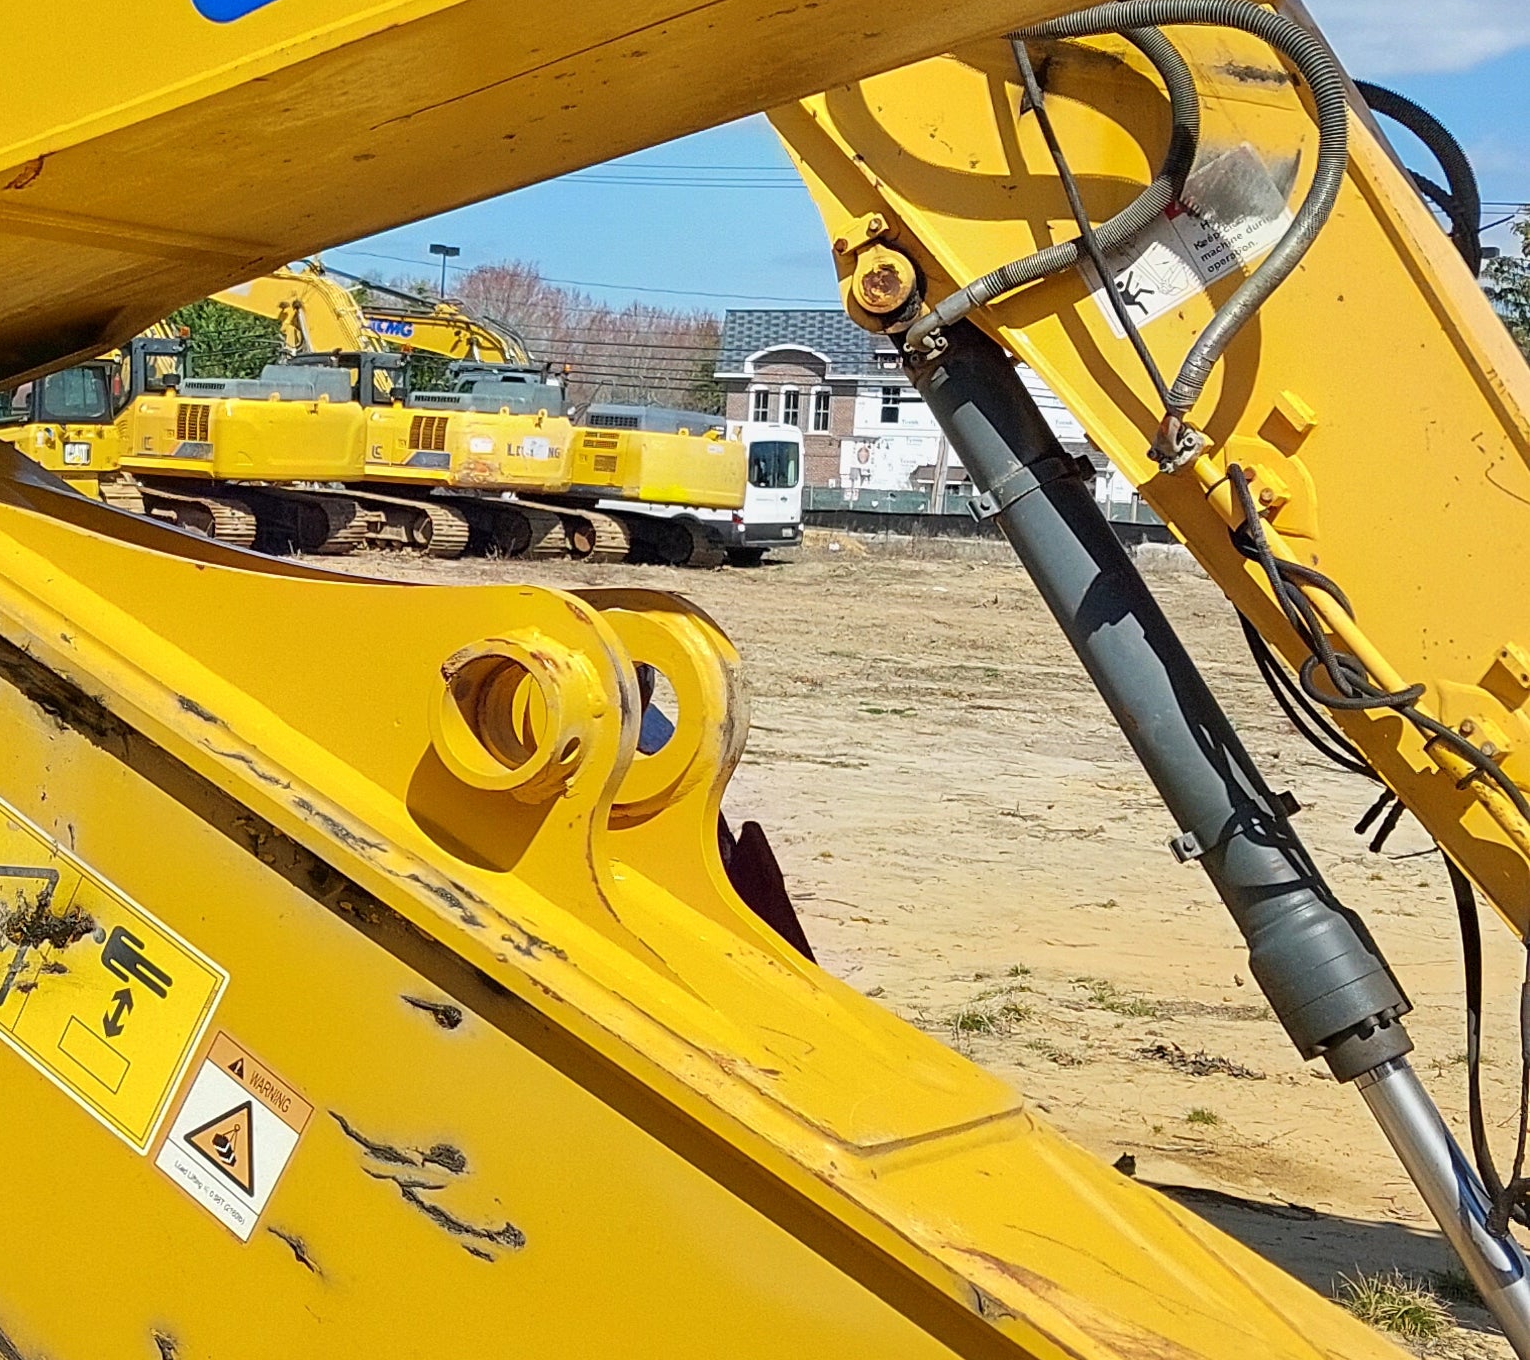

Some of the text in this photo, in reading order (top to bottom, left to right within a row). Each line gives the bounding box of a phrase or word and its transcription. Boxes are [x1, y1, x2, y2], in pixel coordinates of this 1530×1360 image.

[1193, 231, 1221, 251] Keep
[1201, 233, 1243, 262] machine
[1207, 240, 1258, 273] operation.
[250, 1071, 291, 1113] WARNING
